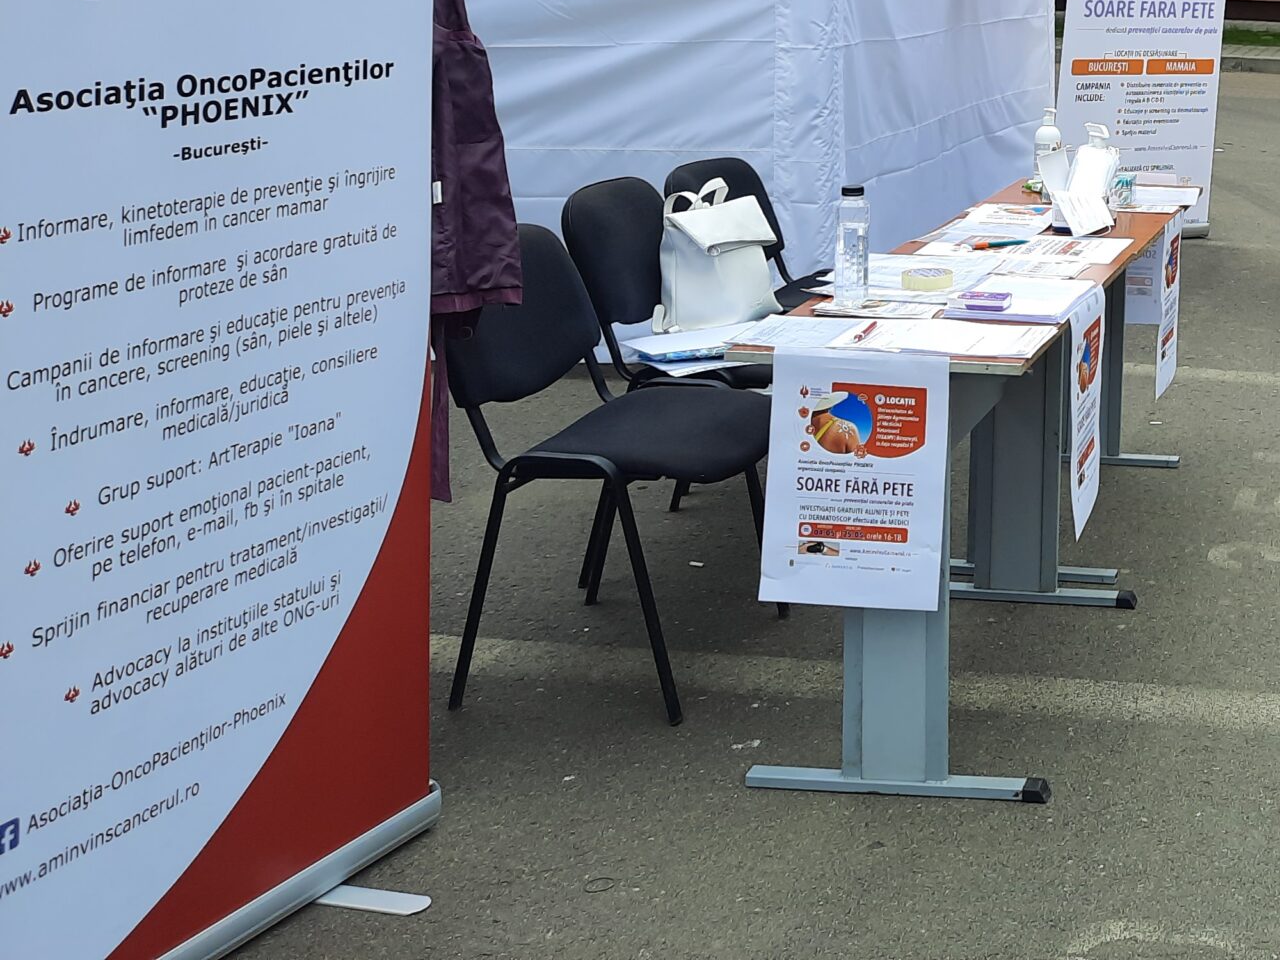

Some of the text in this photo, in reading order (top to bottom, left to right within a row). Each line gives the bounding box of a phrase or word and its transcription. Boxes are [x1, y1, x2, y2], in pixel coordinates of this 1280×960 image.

[1084, 0, 1135, 18] SOARE
[1181, 2, 1215, 19] PETE
[1076, 82, 1111, 91] CAMPANIA
[1088, 62, 1196, 74] BUCUREȘTI MAMAIA
[18, 213, 114, 242] Informare,
[122, 192, 225, 224] kinetoterapie
[231, 188, 248, 203] de
[345, 166, 396, 188] îngrijire
[124, 198, 329, 247] limfedem în cancer mamar
[34, 281, 118, 312] Programe
[125, 274, 145, 292] de
[152, 258, 226, 287] informare
[254, 240, 317, 265] acordare
[324, 224, 377, 255] gratuită
[382, 224, 397, 239] de
[179, 264, 287, 308] proteze de sân
[7, 352, 92, 391] Campanii
[100, 348, 120, 367] de
[127, 328, 204, 361] informare
[294, 296, 340, 322] pentru
[56, 382, 71, 402] în
[78, 366, 151, 396] cancere,
[158, 343, 229, 376] screening
[236, 332, 272, 358] (sân,
[278, 320, 312, 347] piele
[335, 304, 378, 329] altele)
[50, 412, 149, 451] Îndrumare,
[156, 386, 233, 421] informare,
[312, 346, 378, 375] consiliere
[53, 534, 114, 568] Oferire
[121, 512, 174, 544] suport
[258, 445, 371, 497] pacient-pacient,
[98, 480, 140, 506] Grup
[146, 458, 202, 491] suport:
[208, 432, 283, 470] ArtTerapie
[796, 477, 914, 497] SOARE FĂRĂ PETE
[92, 558, 113, 582] pe
[120, 536, 181, 568] telefon,
[187, 508, 239, 541] e-mail,
[244, 500, 259, 520] fb
[280, 488, 293, 507] în
[298, 472, 344, 502] spitale
[32, 611, 90, 648] Sprijin
[98, 580, 171, 620] financiar
[176, 558, 224, 594] pentru
[146, 546, 298, 625] recuperare medicală
[90, 590, 339, 715] advocacy alături de alte ONG-uri
[92, 645, 172, 692] Advocacy
[178, 636, 190, 654] la
[274, 576, 326, 612] statului
